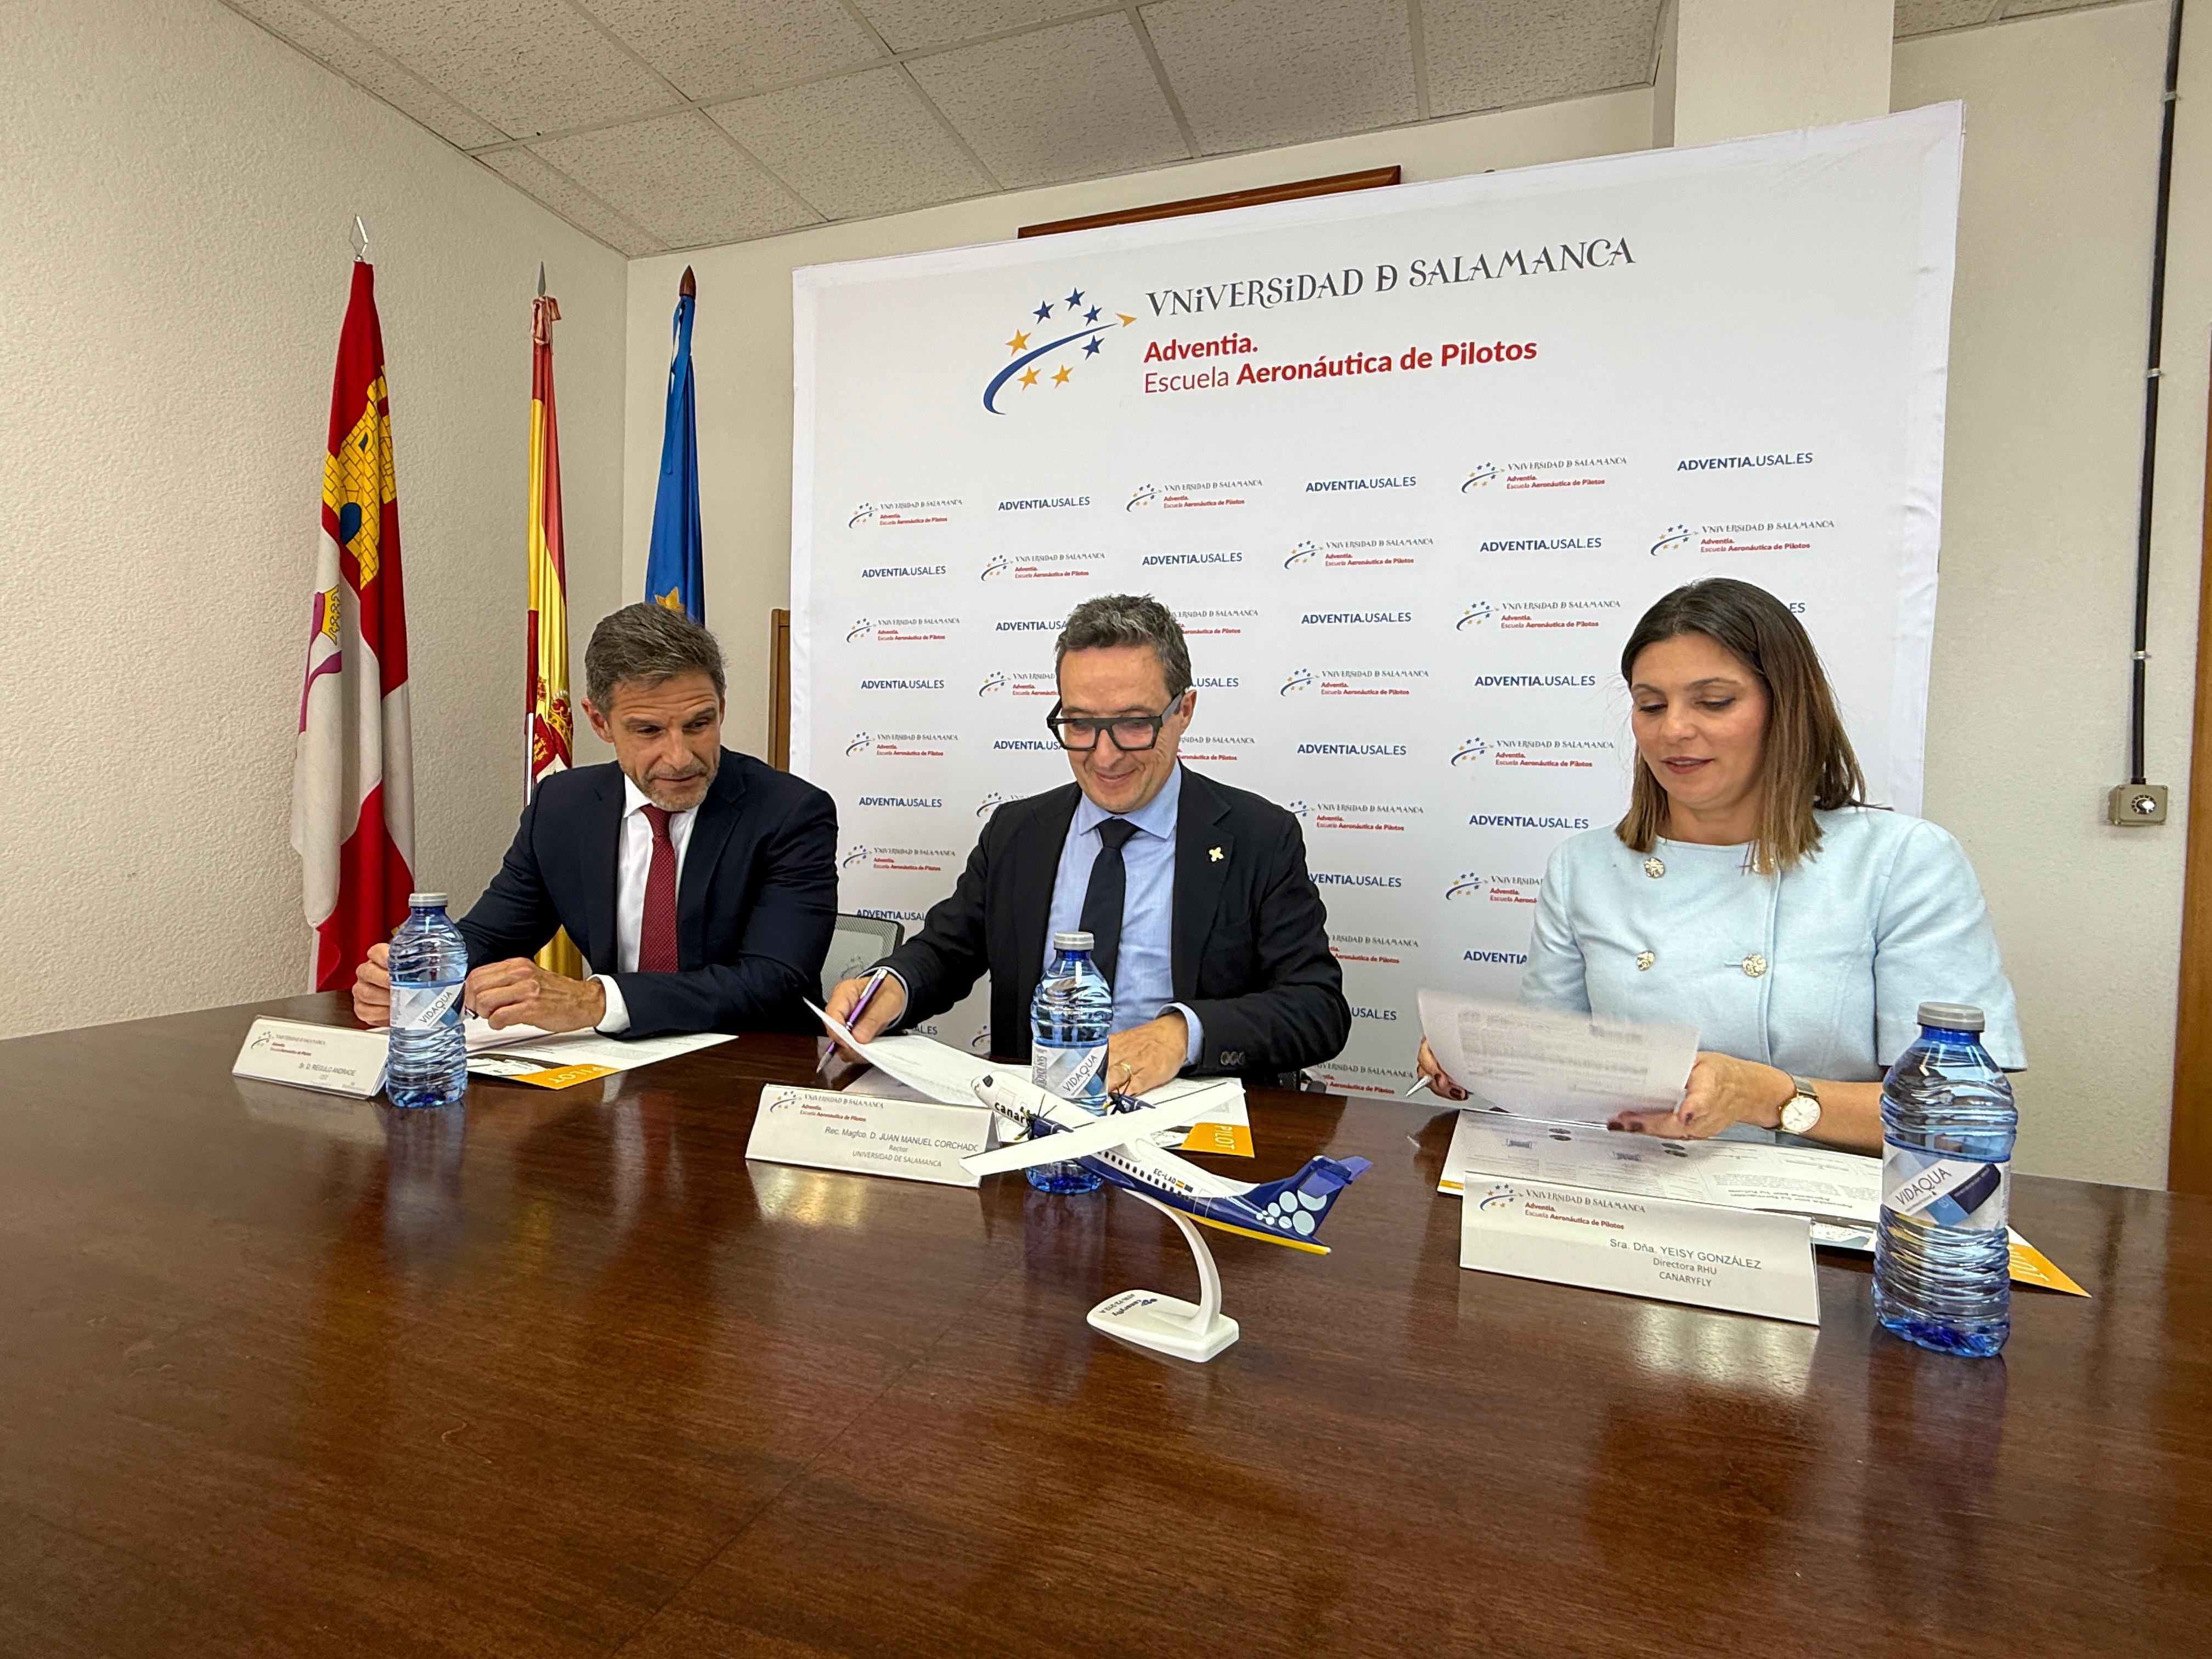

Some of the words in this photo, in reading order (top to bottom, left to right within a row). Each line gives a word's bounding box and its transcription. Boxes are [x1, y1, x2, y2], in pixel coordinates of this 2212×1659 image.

[1409, 236, 1635, 287] SALAMANCA
[1144, 332, 1258, 363] Adventia.
[1144, 366, 1229, 394] Escuela
[1236, 350, 1392, 386] Aeronáutica
[1400, 346, 1432, 371] de
[1441, 338, 1537, 368] Pilotos
[1677, 453, 1813, 471] ADVENTIA.USAL.ES
[1306, 477, 1416, 492] ADVENTIA.USAL.ES
[998, 496, 1090, 511] ADVENTIA.USAL.ES
[1776, 521, 1834, 529] SALAMANCA
[1480, 538, 1601, 552] ADVENTIA.USAL.ES
[1142, 552, 1242, 565] ADVENTIA.USAL.ES
[862, 566, 946, 578] ADVENTIA.USAL.ES
[1301, 612, 1411, 624] ADVENTIA.USAL.ES
[996, 621, 1066, 630] ADVENTIA.USA
[861, 680, 944, 689] ADVENTIA.USAL.ES
[1475, 676, 1595, 686] ADVENTIA.USAL.ES
[994, 741, 1061, 750] ADVENTIA.US
[1297, 744, 1406, 755] ADVENTIA.USAL.ES
[859, 797, 941, 808] ADVENTIA.USAL.ES
[1469, 815, 1588, 829] ADVENTIA.USAL.ES
[1311, 873, 1402, 887] VENTIA.USAL.ES
[857, 910, 925, 921] ADVENTIA.USAL
[419, 991, 452, 1023] VIDAQUA
[1062, 1054, 1097, 1092] VIDAQUA
[879, 1132, 899, 1142] JUAN
[901, 1135, 933, 1147] MANUEL
[1215, 1125, 1235, 1150] PILOT
[852, 1150, 893, 1161] UNIVERSIDAD
[1895, 1167, 1952, 1205] VIDAQUA
[1610, 1238, 1630, 1250] Sra.
[1660, 1246, 1694, 1259] YEISY
[1697, 1251, 1762, 1269] GONZÁLEZ
[1653, 1257, 1695, 1272] Directora
[1697, 1265, 1717, 1275] RHU
[1659, 1271, 1712, 1287] CANARYFLY
